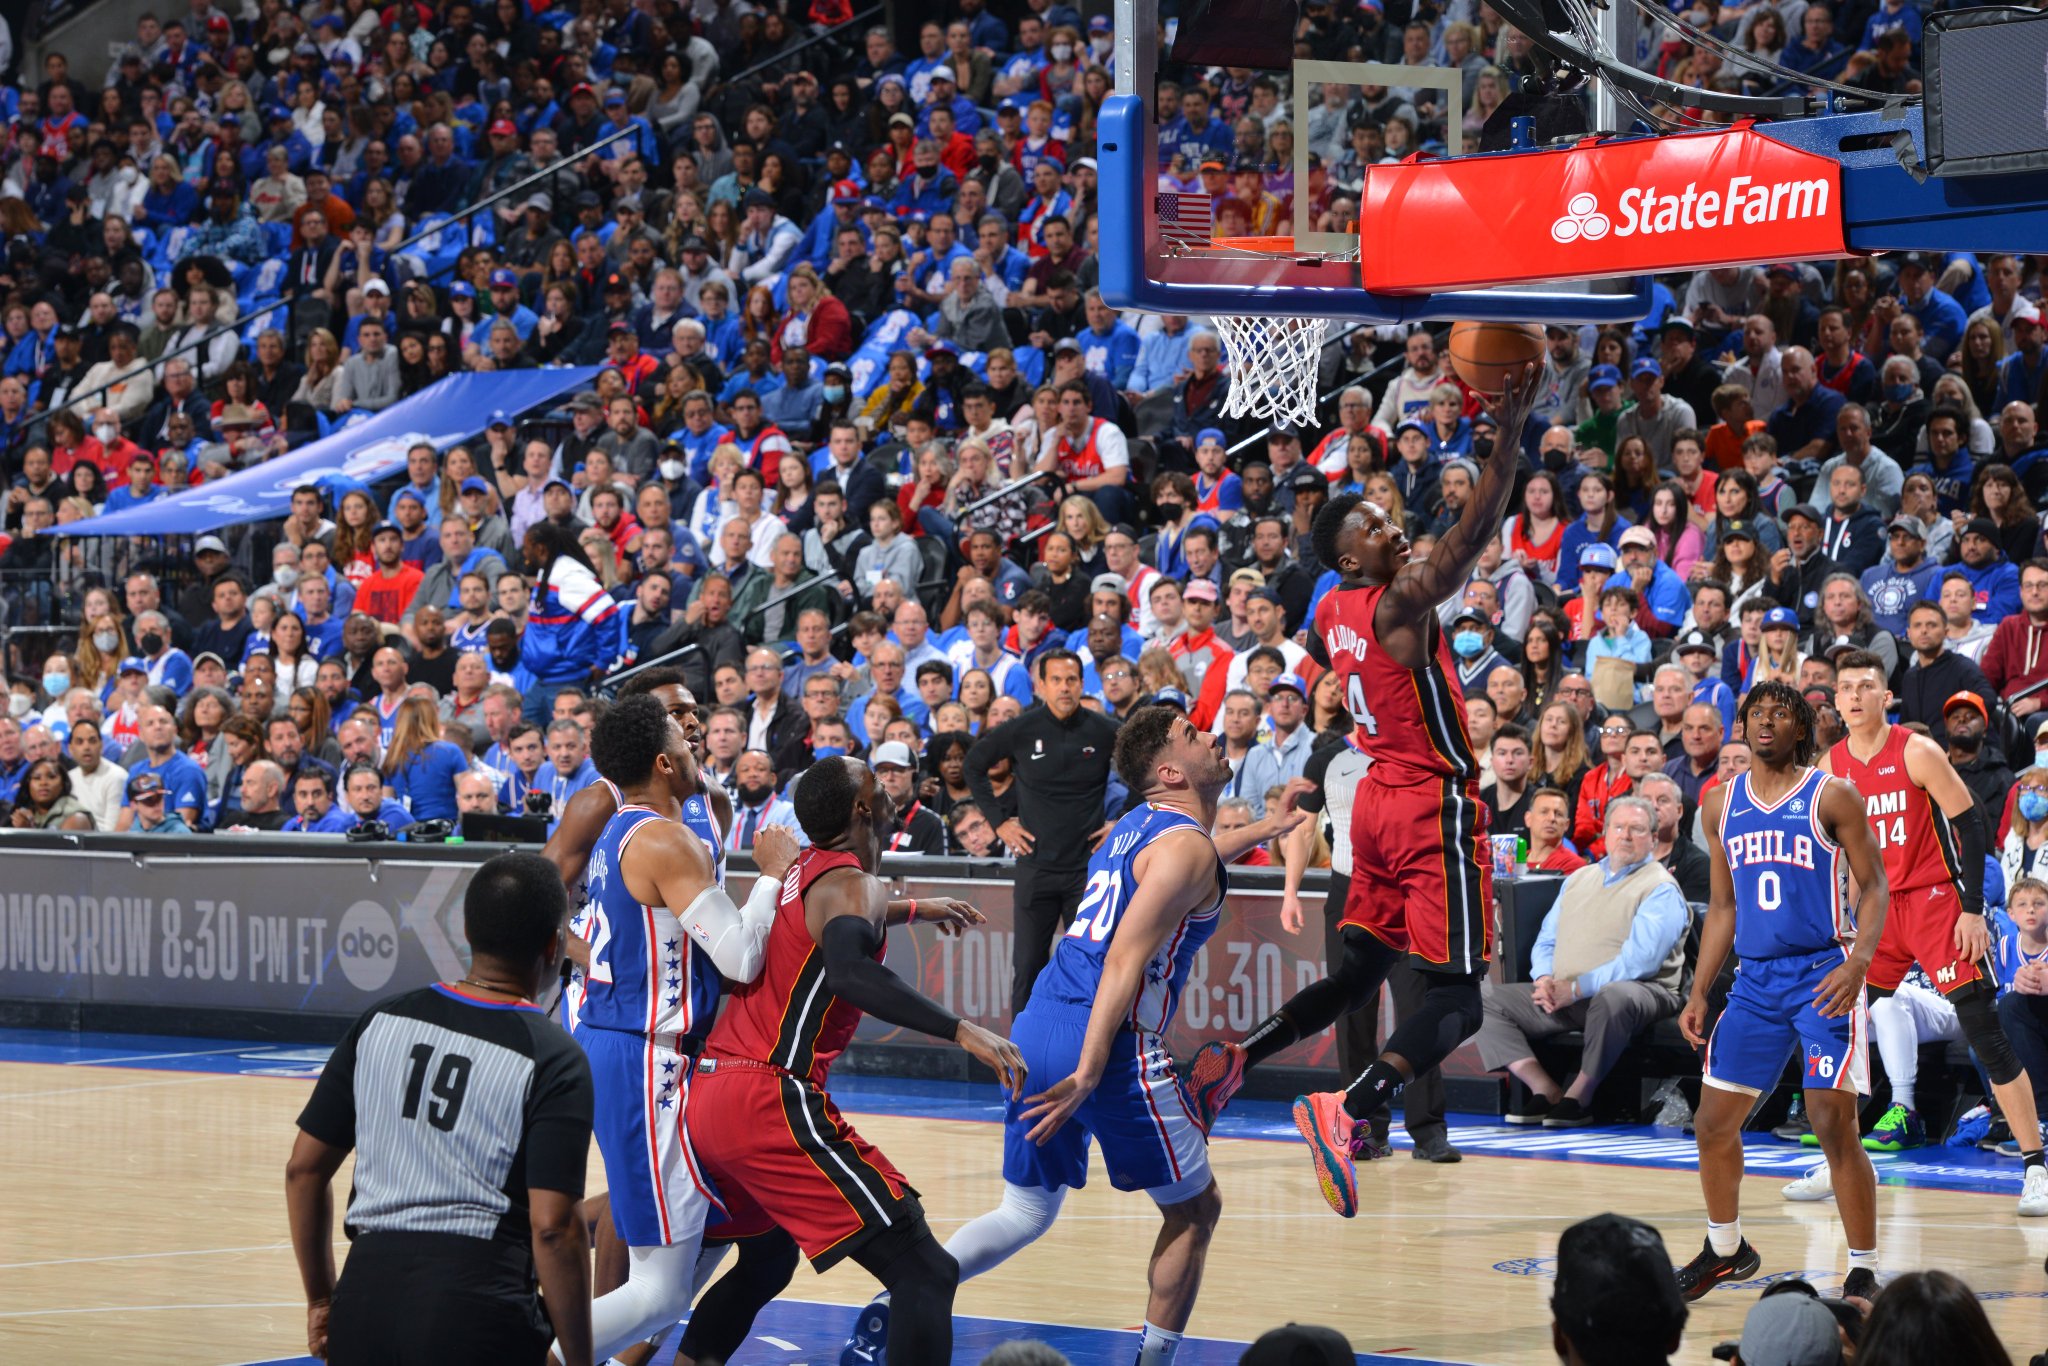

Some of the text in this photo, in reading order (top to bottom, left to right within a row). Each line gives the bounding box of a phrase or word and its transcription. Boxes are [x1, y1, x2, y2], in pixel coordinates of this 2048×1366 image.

[1347, 672, 1378, 736] 4
[1878, 765, 1896, 776] UKG
[1863, 789, 1907, 817] AMI
[1727, 829, 1815, 871] PHILA
[1875, 816, 1907, 849] 14
[1064, 868, 1122, 942] 20
[1758, 870, 1782, 911] 0
[0, 893, 328, 985] MORROW 8:30 PM ET
[341, 926, 395, 960] abc
[1185, 941, 1283, 1033] 8:30
[1808, 1055, 1834, 1078] 76
[401, 1043, 473, 1132] 19
